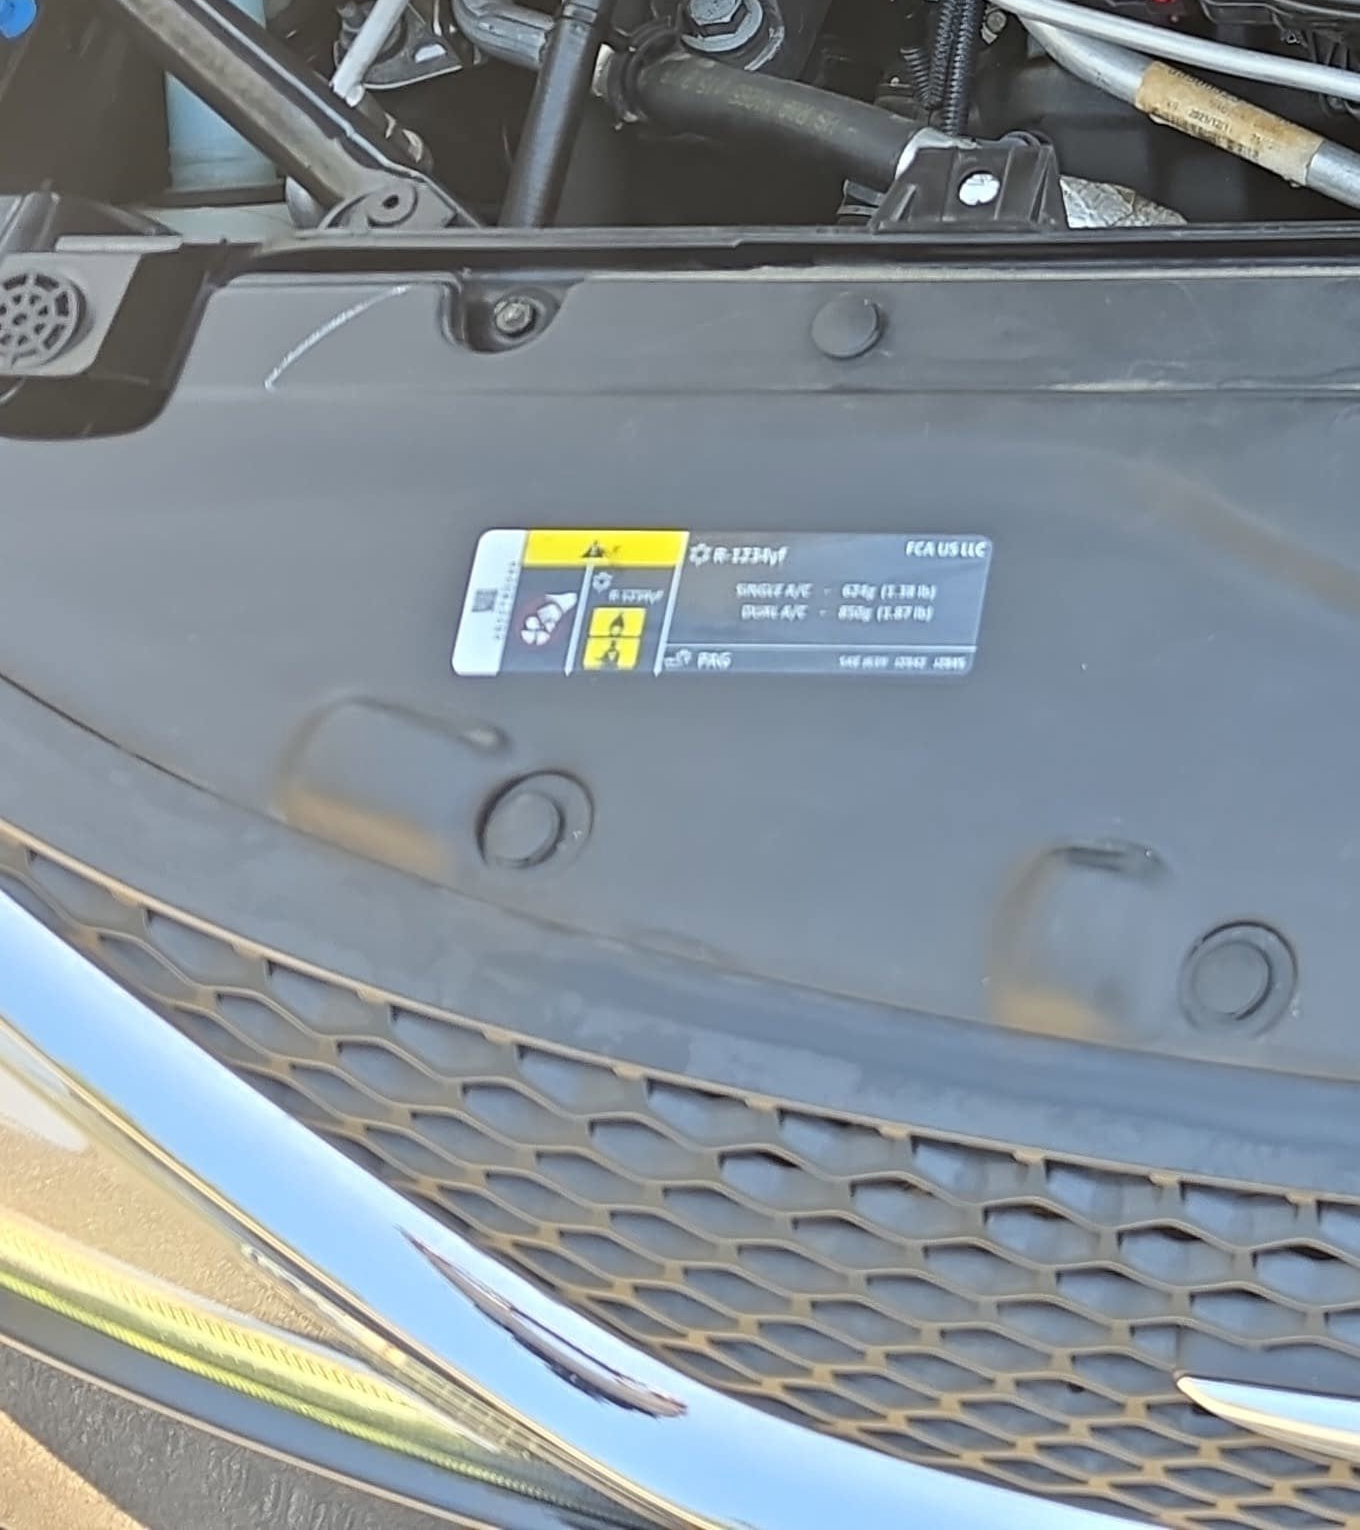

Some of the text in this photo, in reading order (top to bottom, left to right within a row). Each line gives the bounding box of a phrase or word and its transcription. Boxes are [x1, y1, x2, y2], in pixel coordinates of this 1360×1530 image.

[905, 541, 987, 559] FCA US LLC
